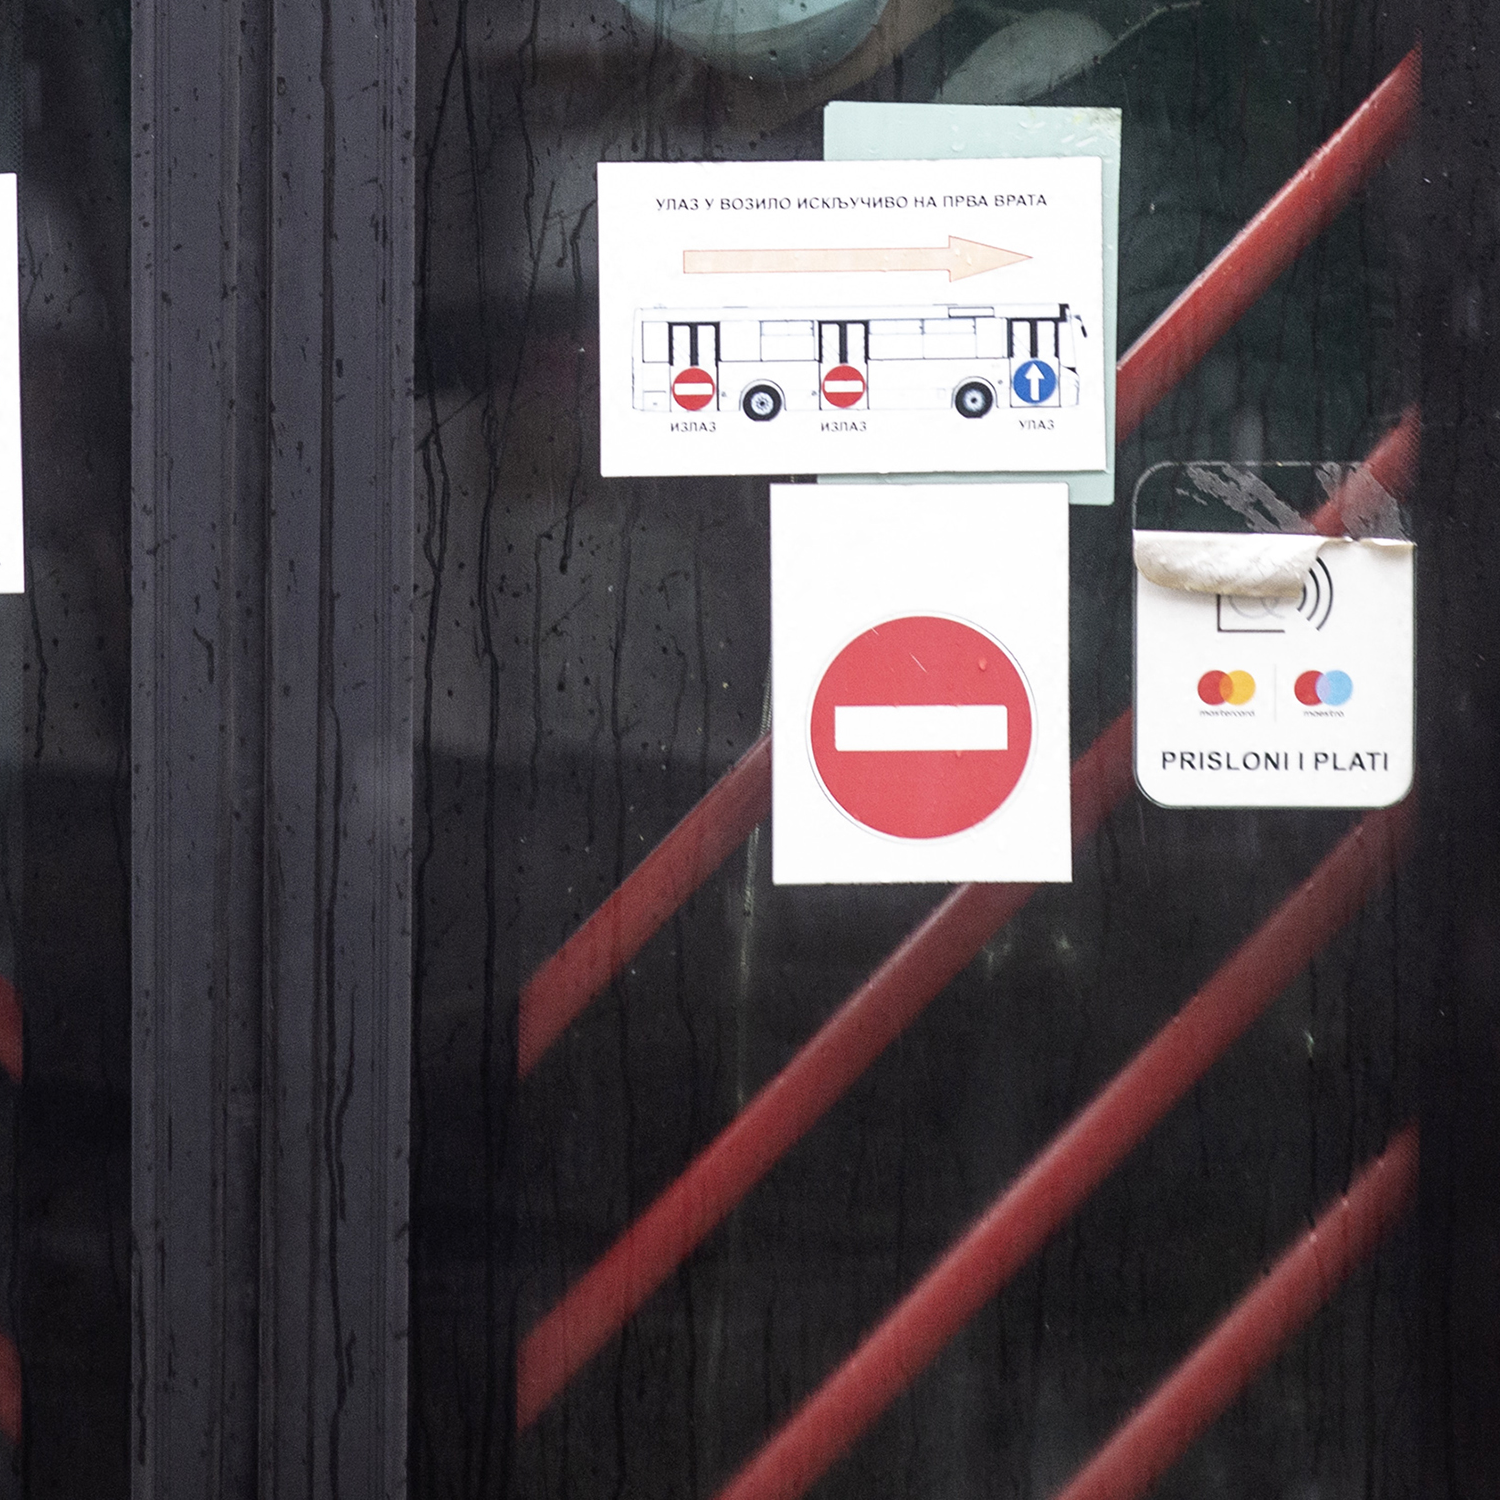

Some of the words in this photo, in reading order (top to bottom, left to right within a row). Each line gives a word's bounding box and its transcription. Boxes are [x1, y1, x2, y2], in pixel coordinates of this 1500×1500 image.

[656, 198, 699, 211] УЛАЗ
[705, 198, 714, 210] У
[720, 197, 791, 210] ВОЗИЛО
[797, 196, 908, 210] ИСКЉУЧИВО
[914, 196, 937, 208] НА
[943, 195, 988, 208] ПРВА
[994, 194, 1048, 207] ВРАТА
[670, 420, 717, 433] ИЗЛАЗ
[820, 420, 867, 433] ИЗЛАЗ
[1018, 419, 1055, 432] УЛАЗ
[1162, 751, 1288, 771] PRISLONI
[1299, 752, 1303, 771] I
[1314, 752, 1388, 771] PLATI
